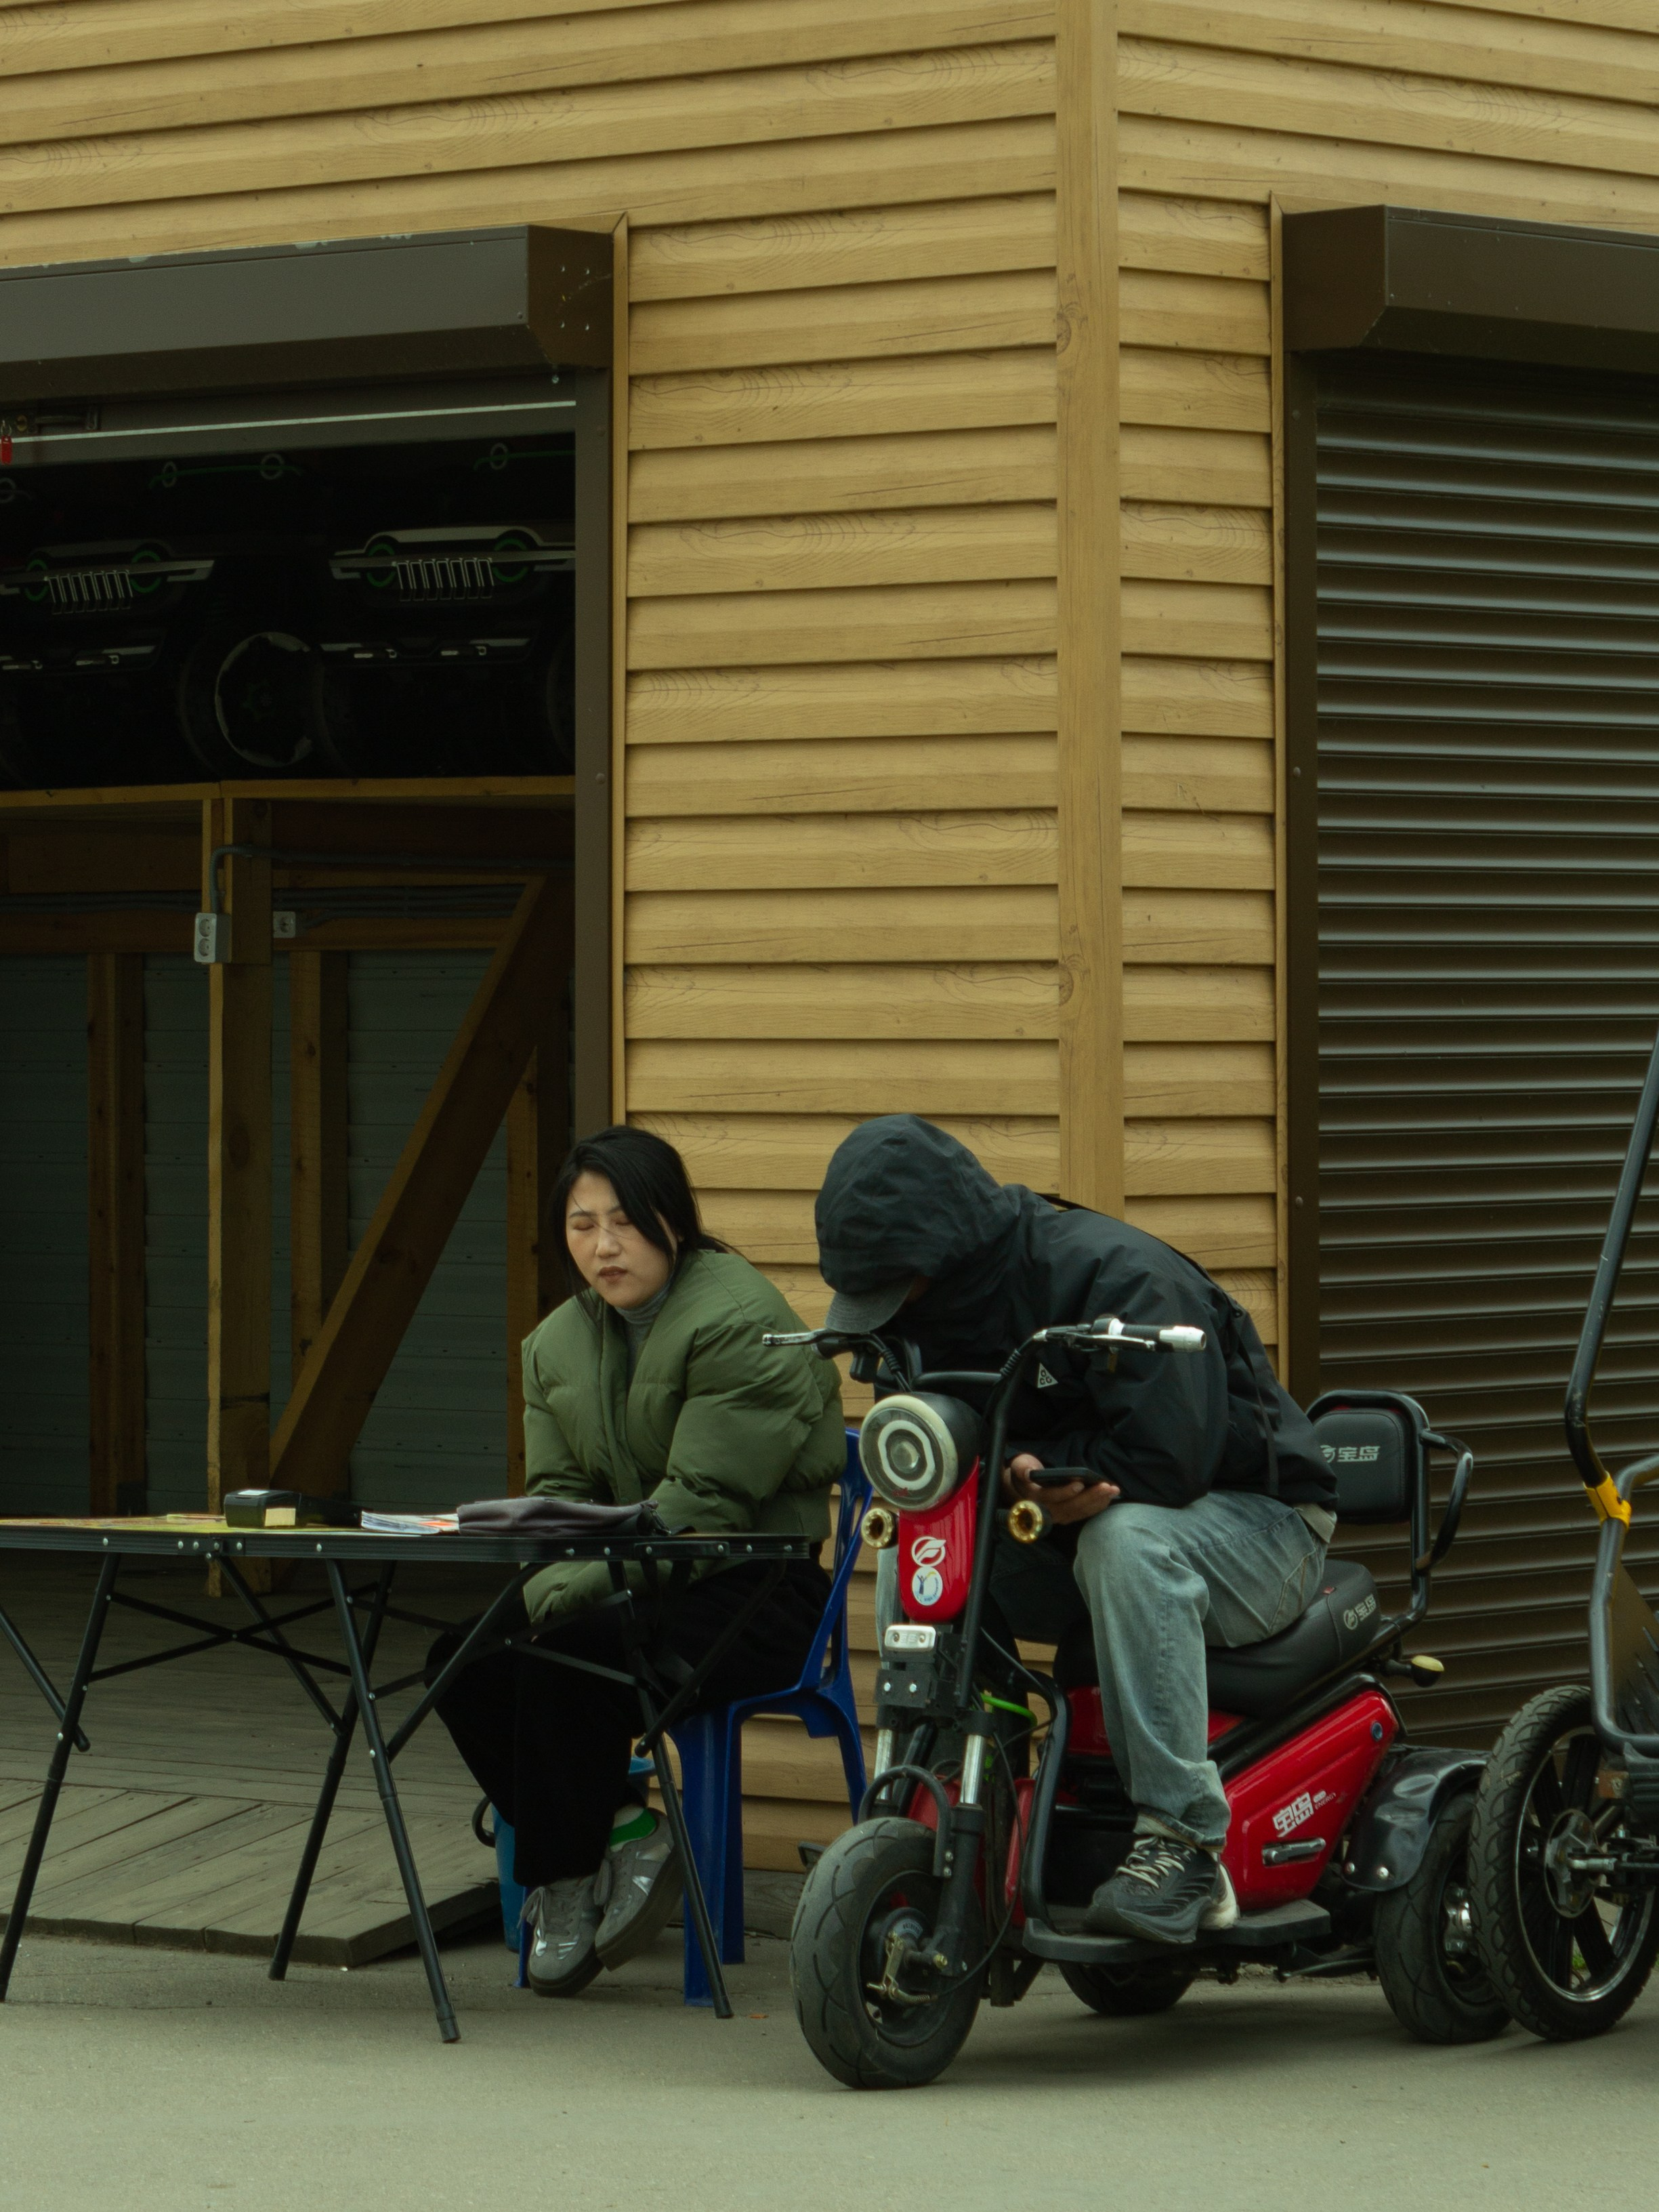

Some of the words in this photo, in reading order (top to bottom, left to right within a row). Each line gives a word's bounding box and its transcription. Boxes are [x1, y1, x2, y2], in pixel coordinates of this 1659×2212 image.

[1337, 1445, 1380, 1462] 宝岛
[1355, 1593, 1377, 1622] 宝岛
[1315, 1792, 1337, 1810] ENERGY
[1273, 1792, 1314, 1838] 宝岛
